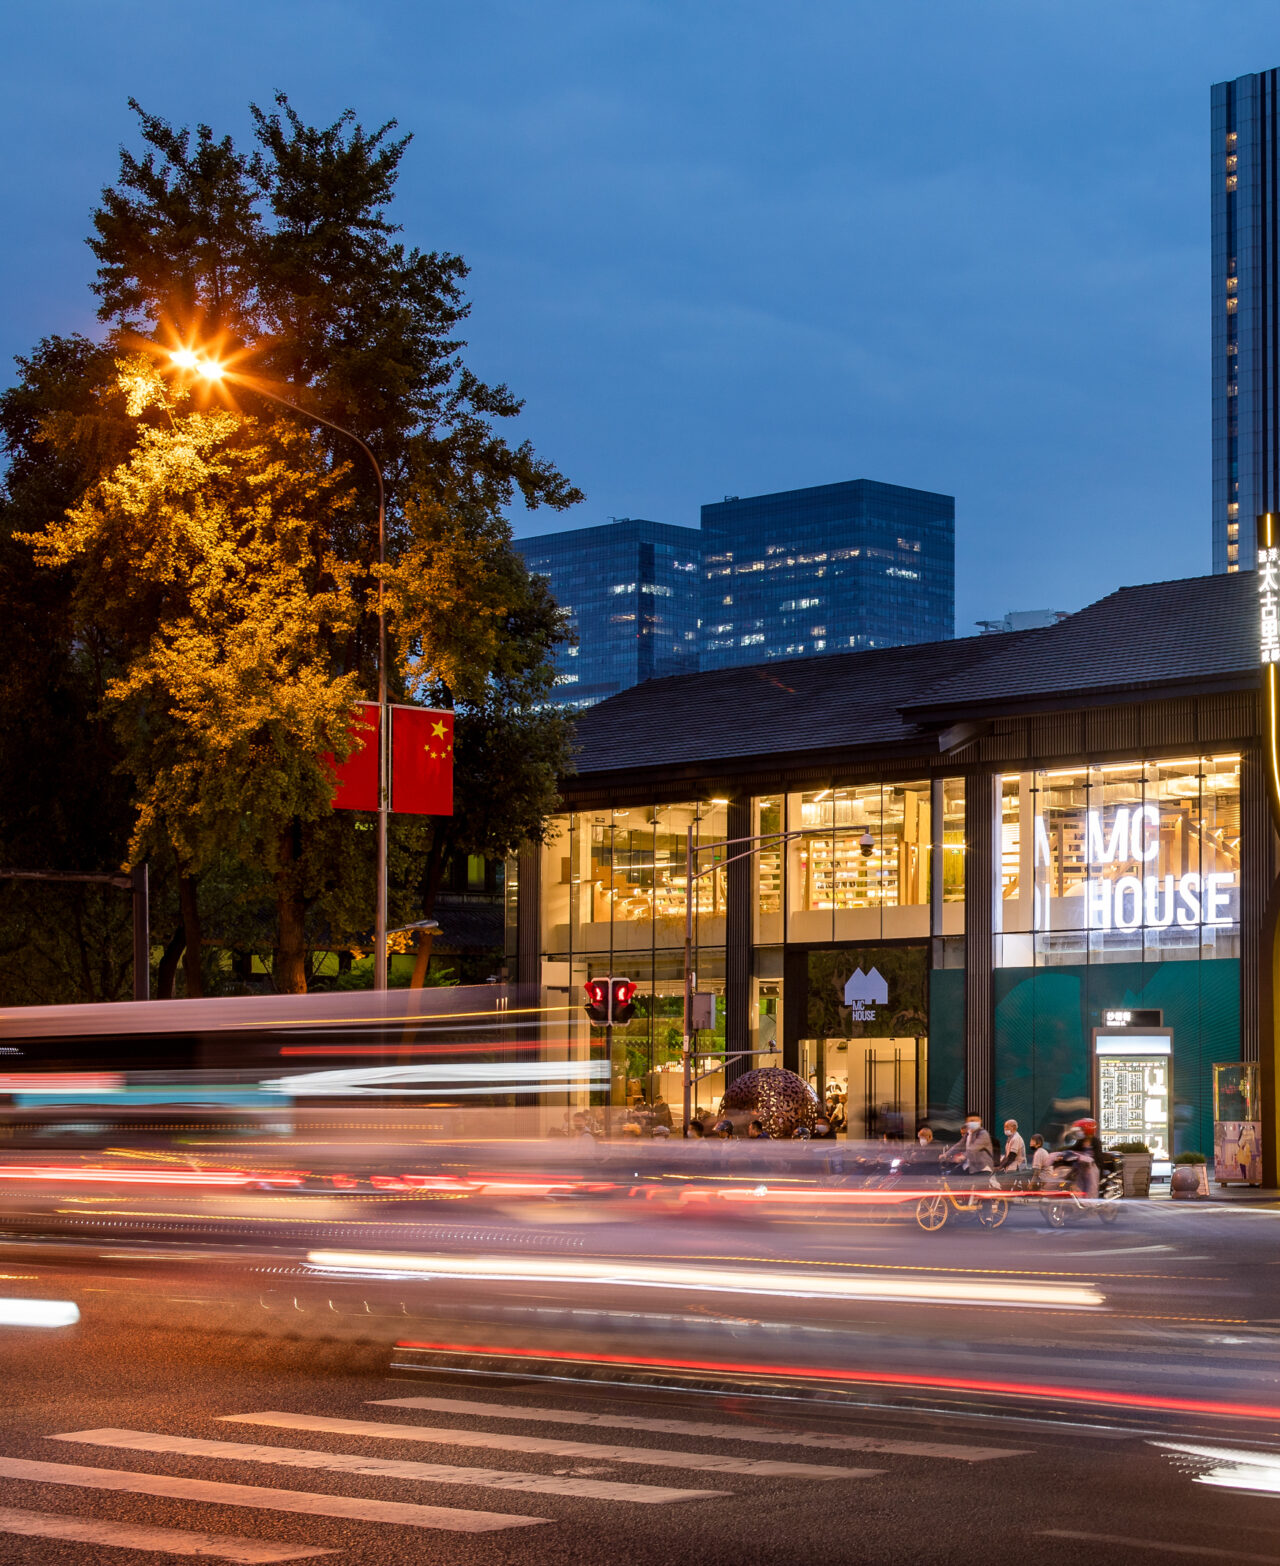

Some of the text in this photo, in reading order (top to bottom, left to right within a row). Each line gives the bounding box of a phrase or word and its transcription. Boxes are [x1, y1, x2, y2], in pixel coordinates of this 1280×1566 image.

[1258, 562, 1280, 650] 太古里
[1085, 805, 1160, 864] MC
[1084, 872, 1234, 934] HOUSE
[852, 1000, 865, 1011] MC
[852, 1010, 876, 1021] HOUSE
